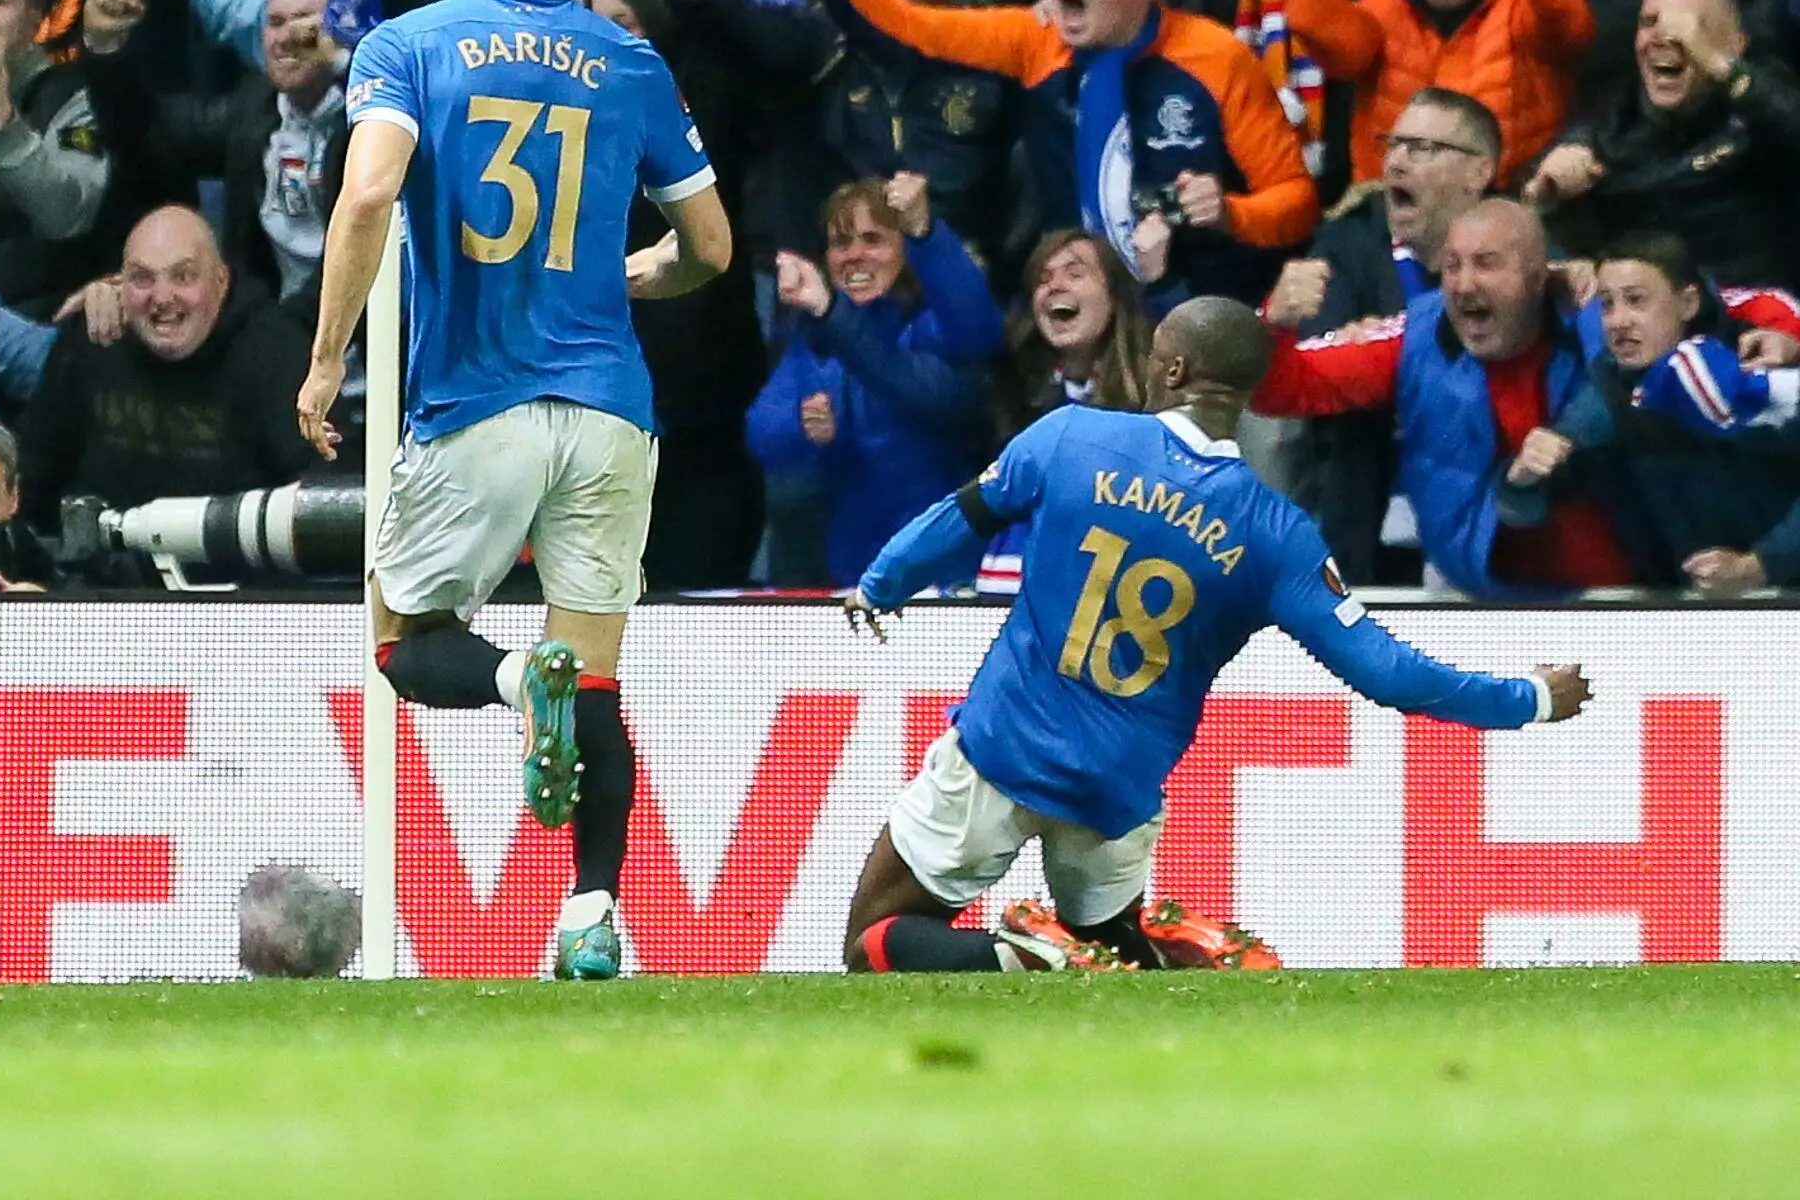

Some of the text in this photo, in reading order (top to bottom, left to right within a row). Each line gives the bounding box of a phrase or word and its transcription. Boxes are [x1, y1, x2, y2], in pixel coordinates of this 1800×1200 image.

[455, 31, 609, 90] BARIŠIĆ
[460, 94, 592, 271] 31
[1093, 469, 1248, 576] KAMARA
[1057, 524, 1197, 698] 18
[326, 687, 1724, 978] WTH
